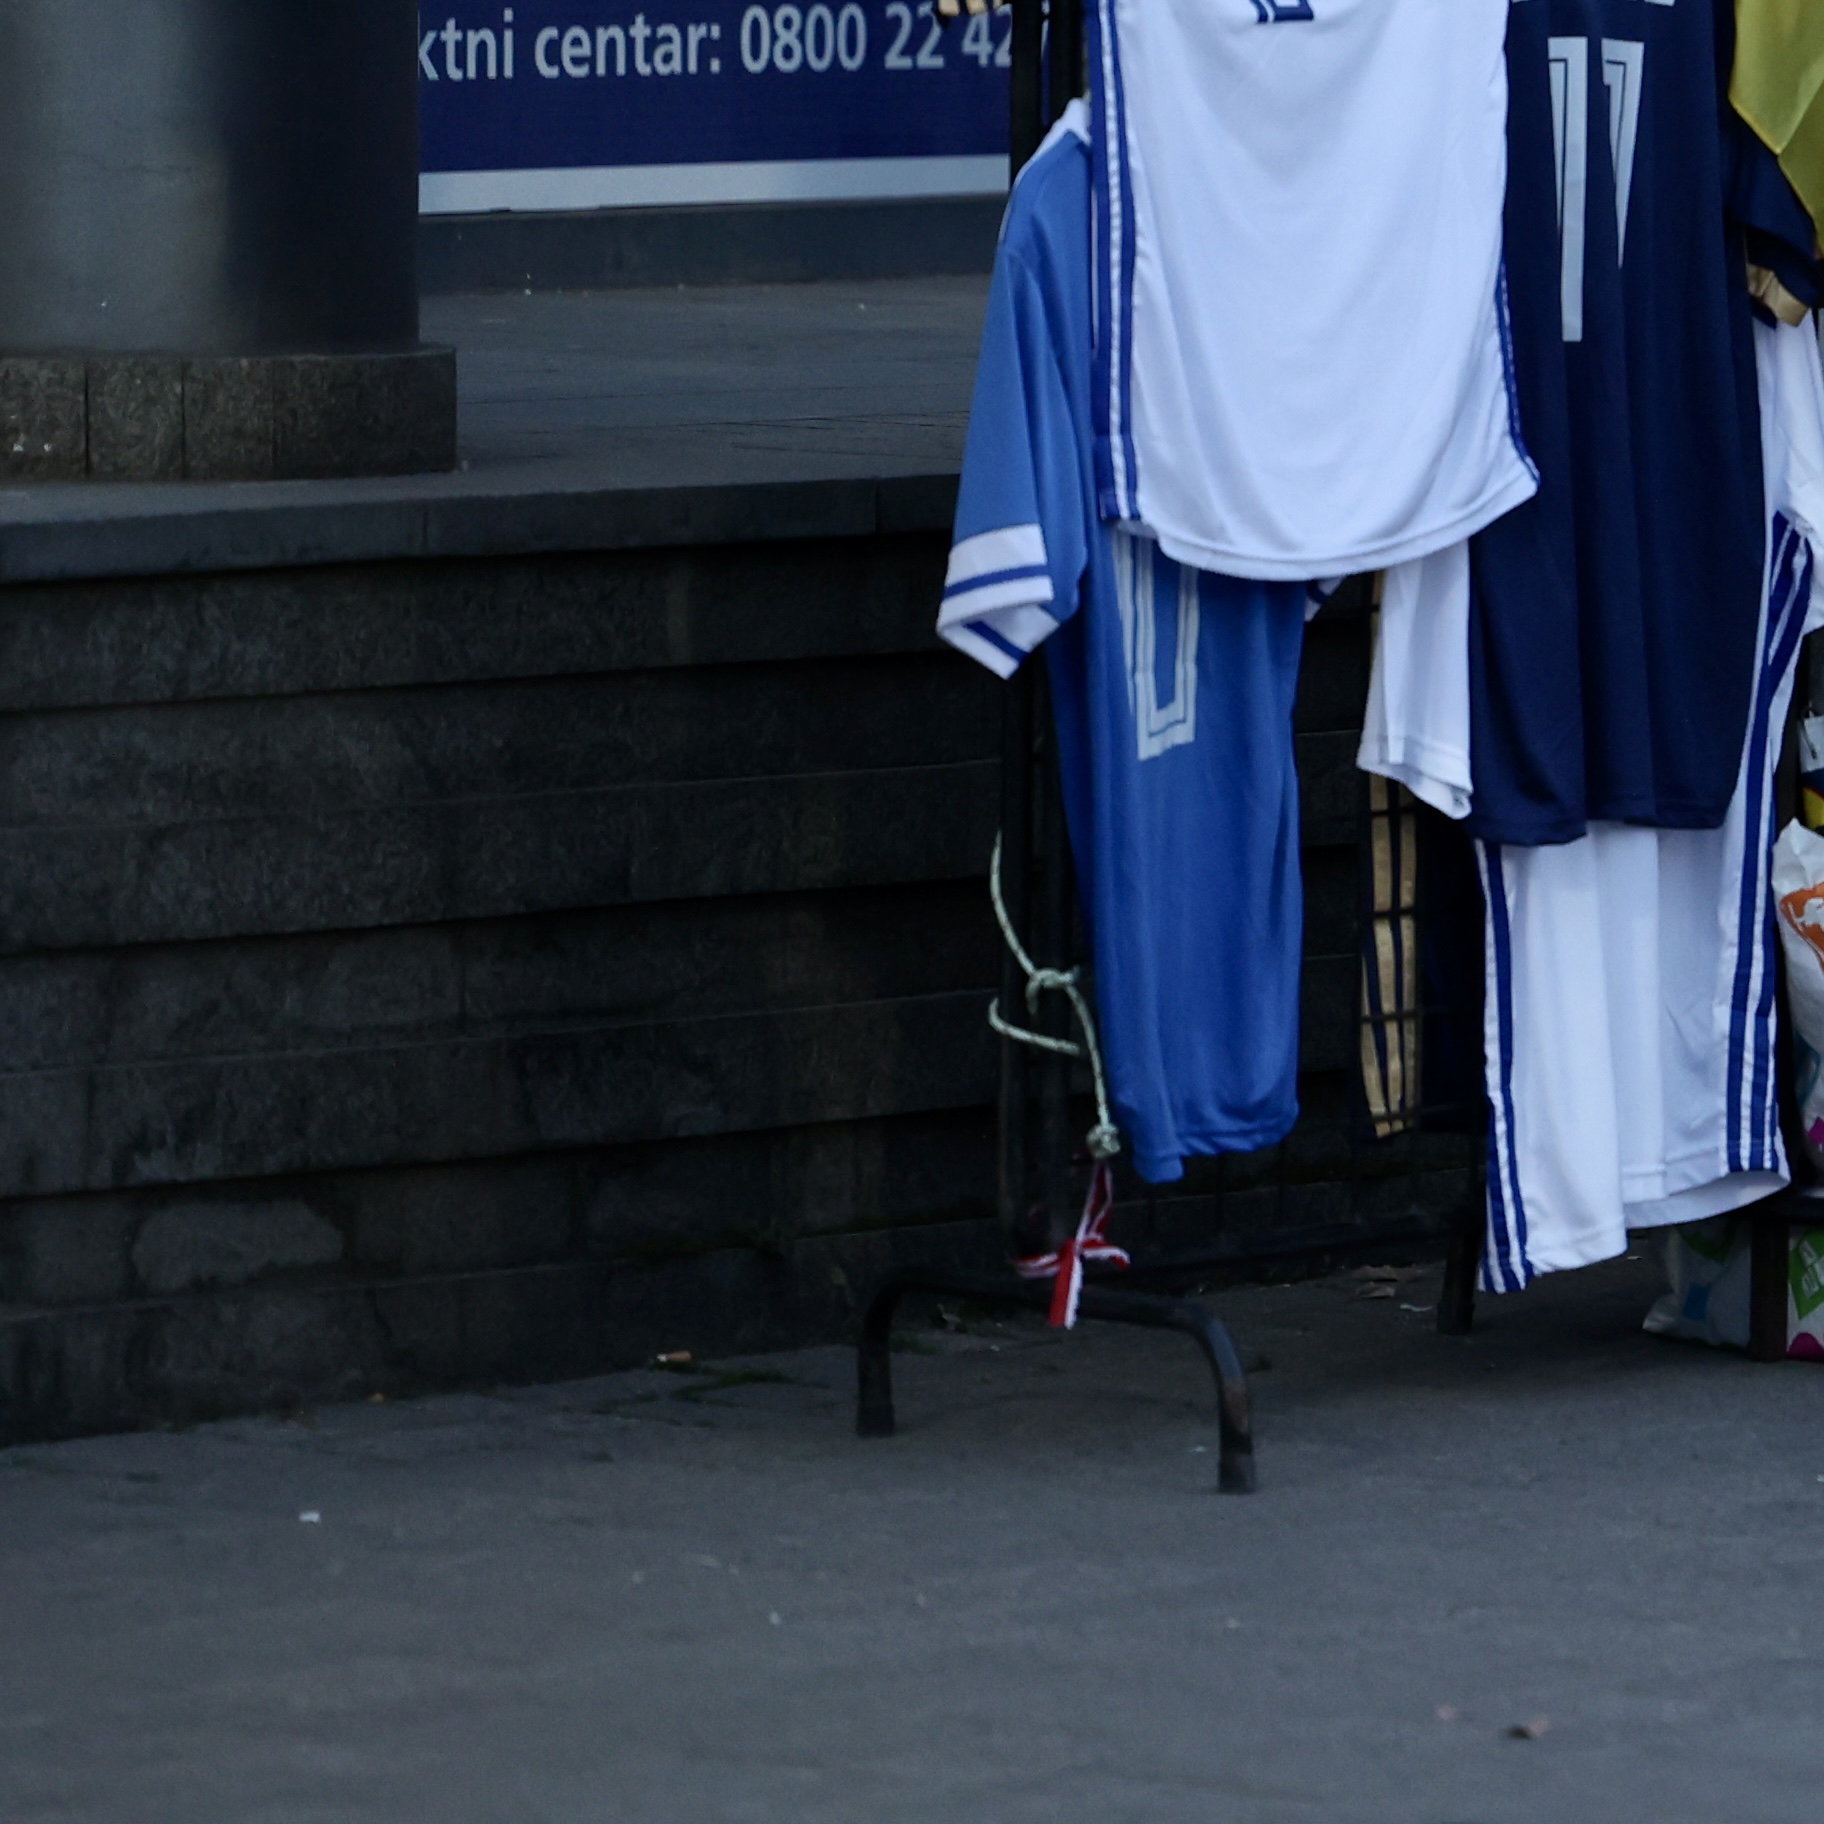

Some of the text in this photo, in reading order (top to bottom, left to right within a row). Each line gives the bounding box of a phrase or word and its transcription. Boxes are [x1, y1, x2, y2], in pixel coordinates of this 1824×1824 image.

[535, 10, 721, 77] centar:
[740, 3, 867, 72] 0800
[884, 1, 944, 68] 22
[1548, 36, 1644, 342] 11
